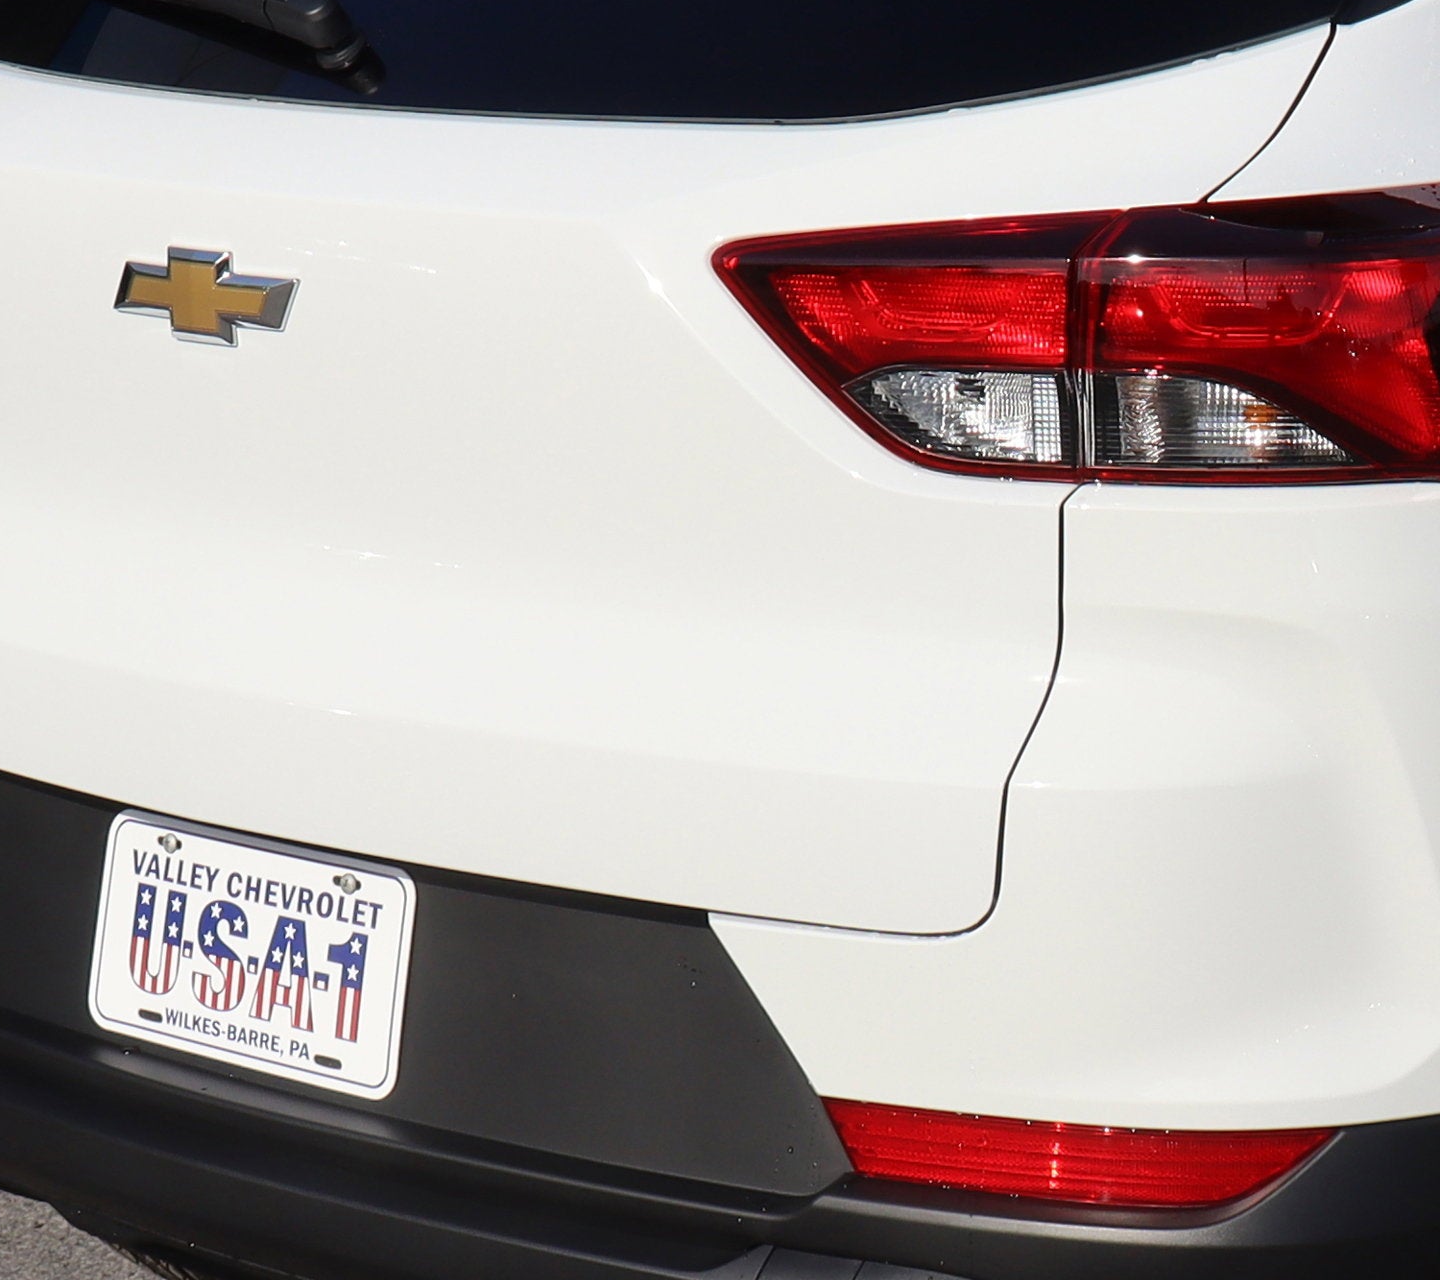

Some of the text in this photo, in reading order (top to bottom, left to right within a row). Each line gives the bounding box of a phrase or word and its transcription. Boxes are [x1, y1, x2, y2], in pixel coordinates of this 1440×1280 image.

[132, 848, 384, 930] VALLEY CHEVROLET
[164, 1007, 311, 1061] WILKES-BARRE, PA
